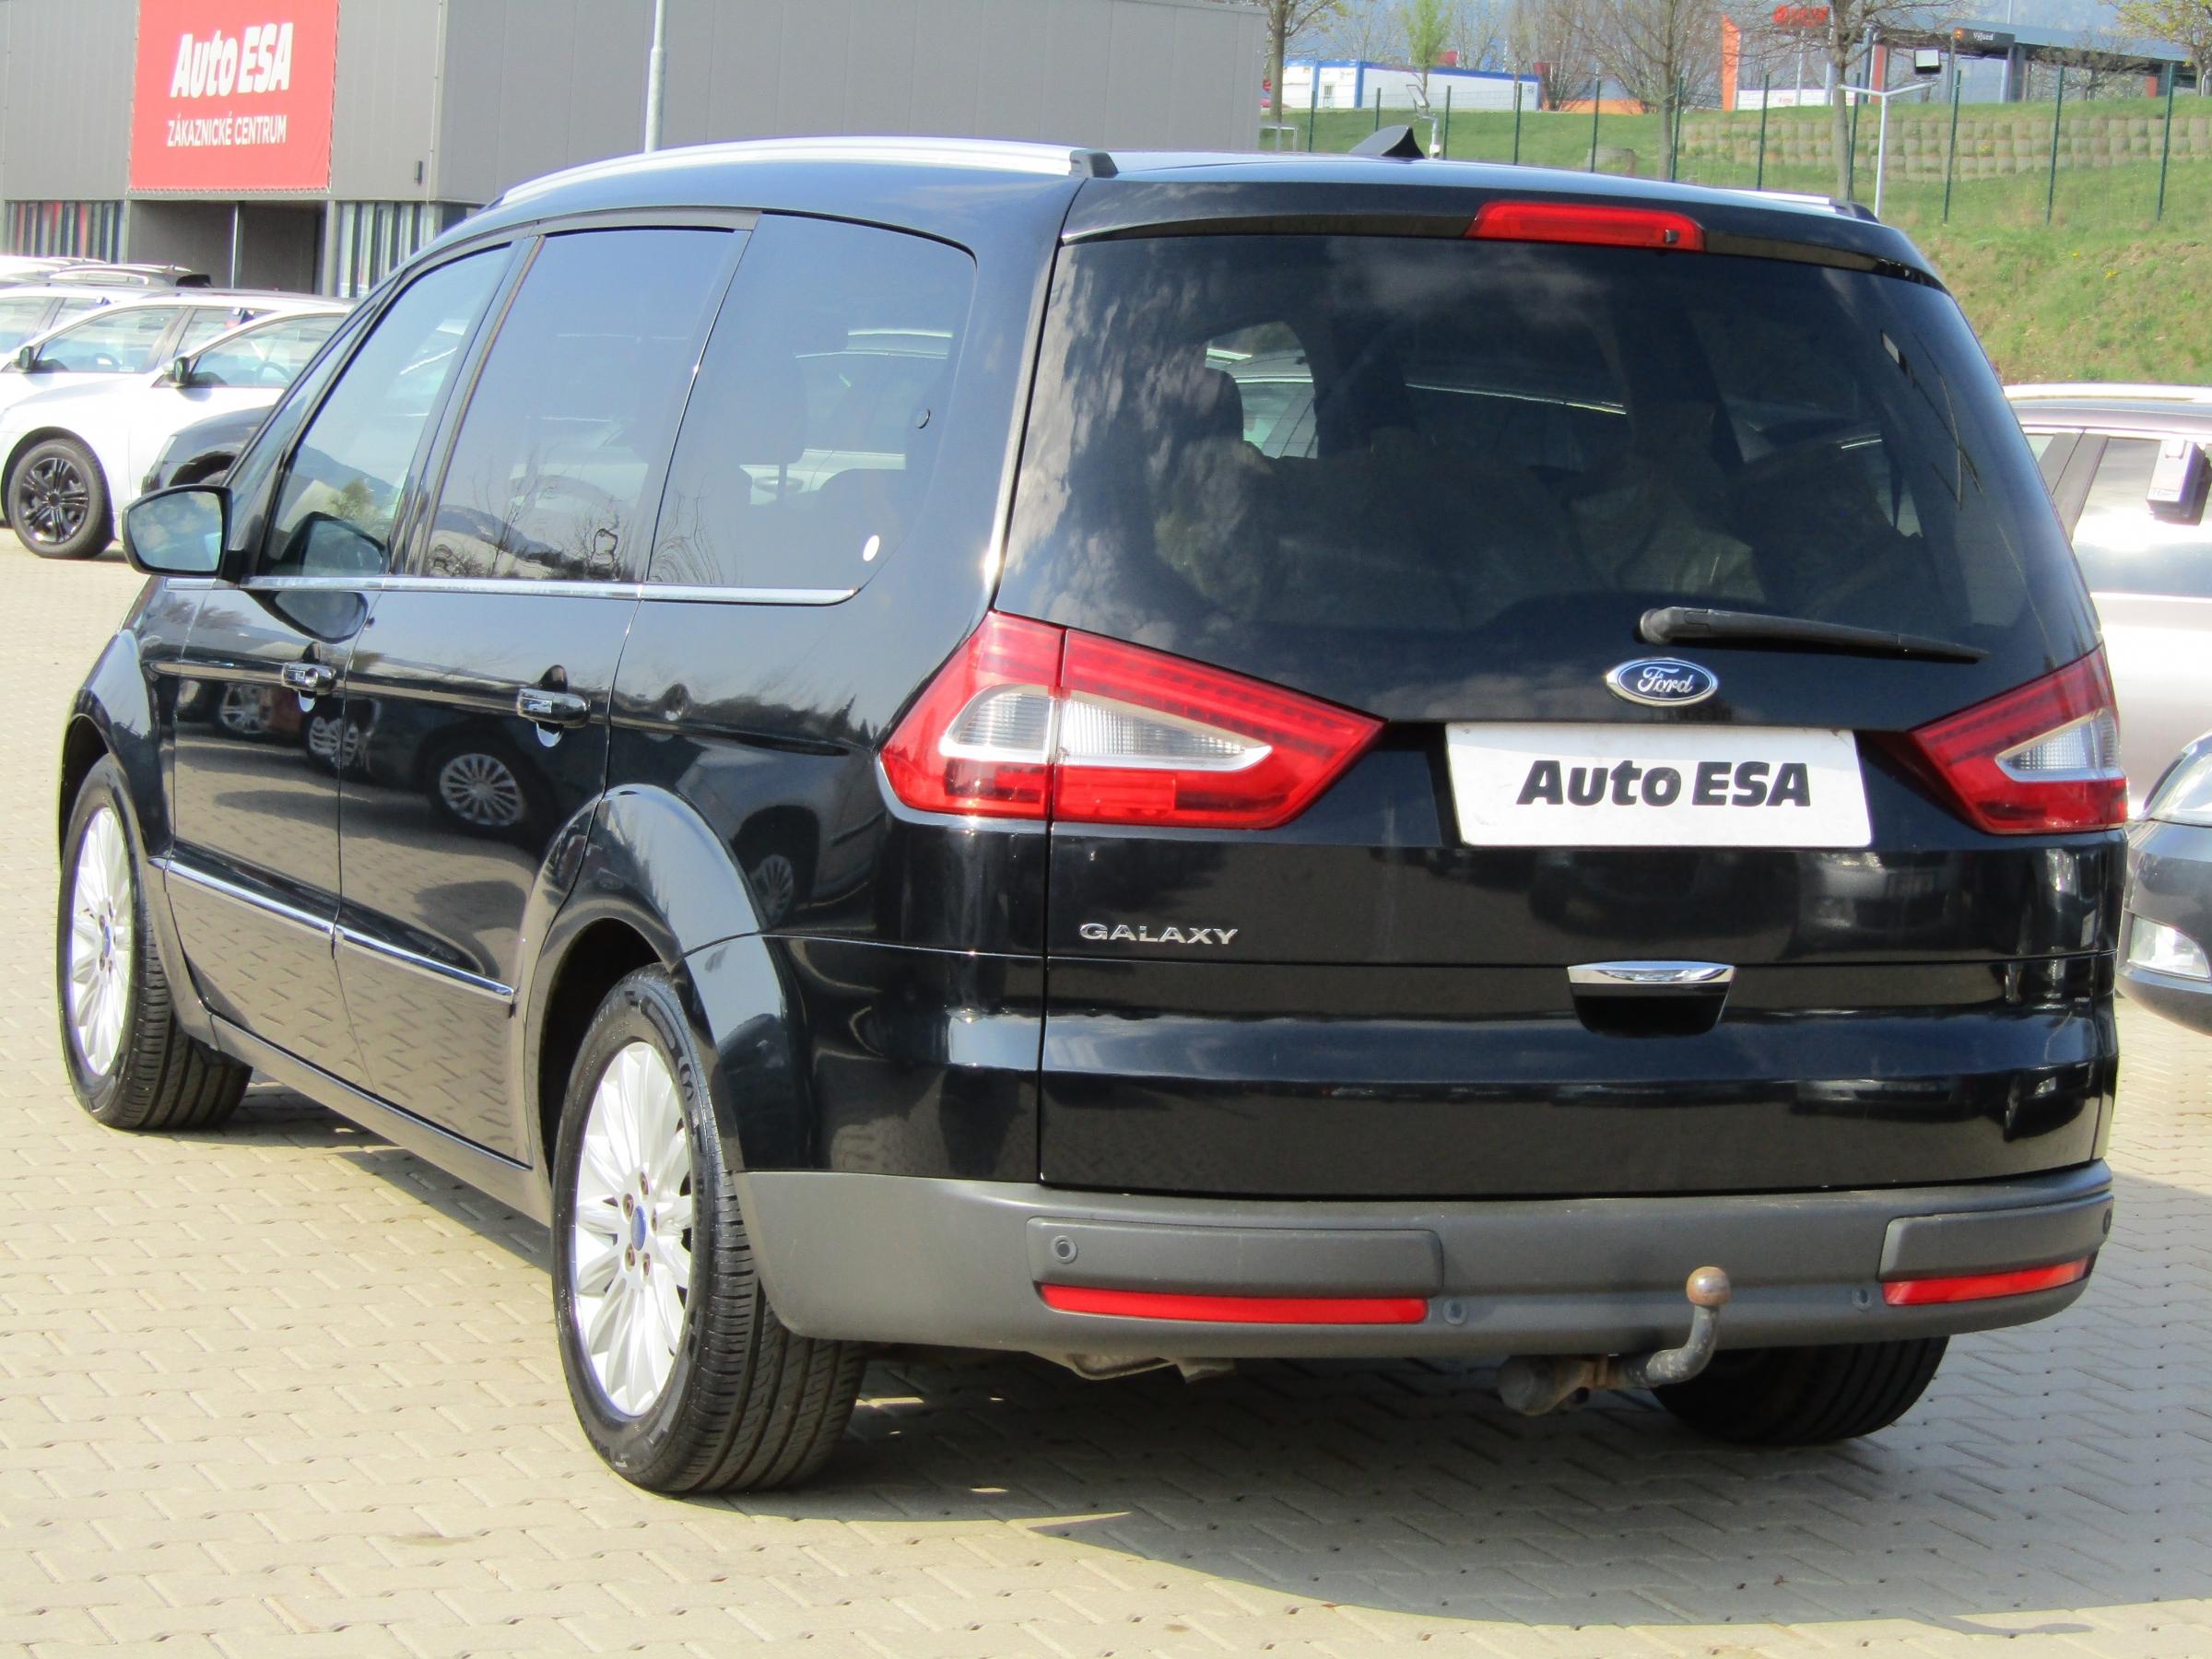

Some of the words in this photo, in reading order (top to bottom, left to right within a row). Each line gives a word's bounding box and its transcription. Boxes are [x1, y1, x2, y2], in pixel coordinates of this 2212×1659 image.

[170, 29, 238, 99] Auto
[237, 22, 294, 93] ESA
[167, 111, 233, 147] ZÁKAZNICKÉ
[234, 114, 288, 146] CENTRUM
[1637, 666, 1695, 694] Ford
[1516, 759, 1682, 807] Auto
[1691, 761, 1811, 807] ESA
[1079, 923, 1239, 945] GALAXY
